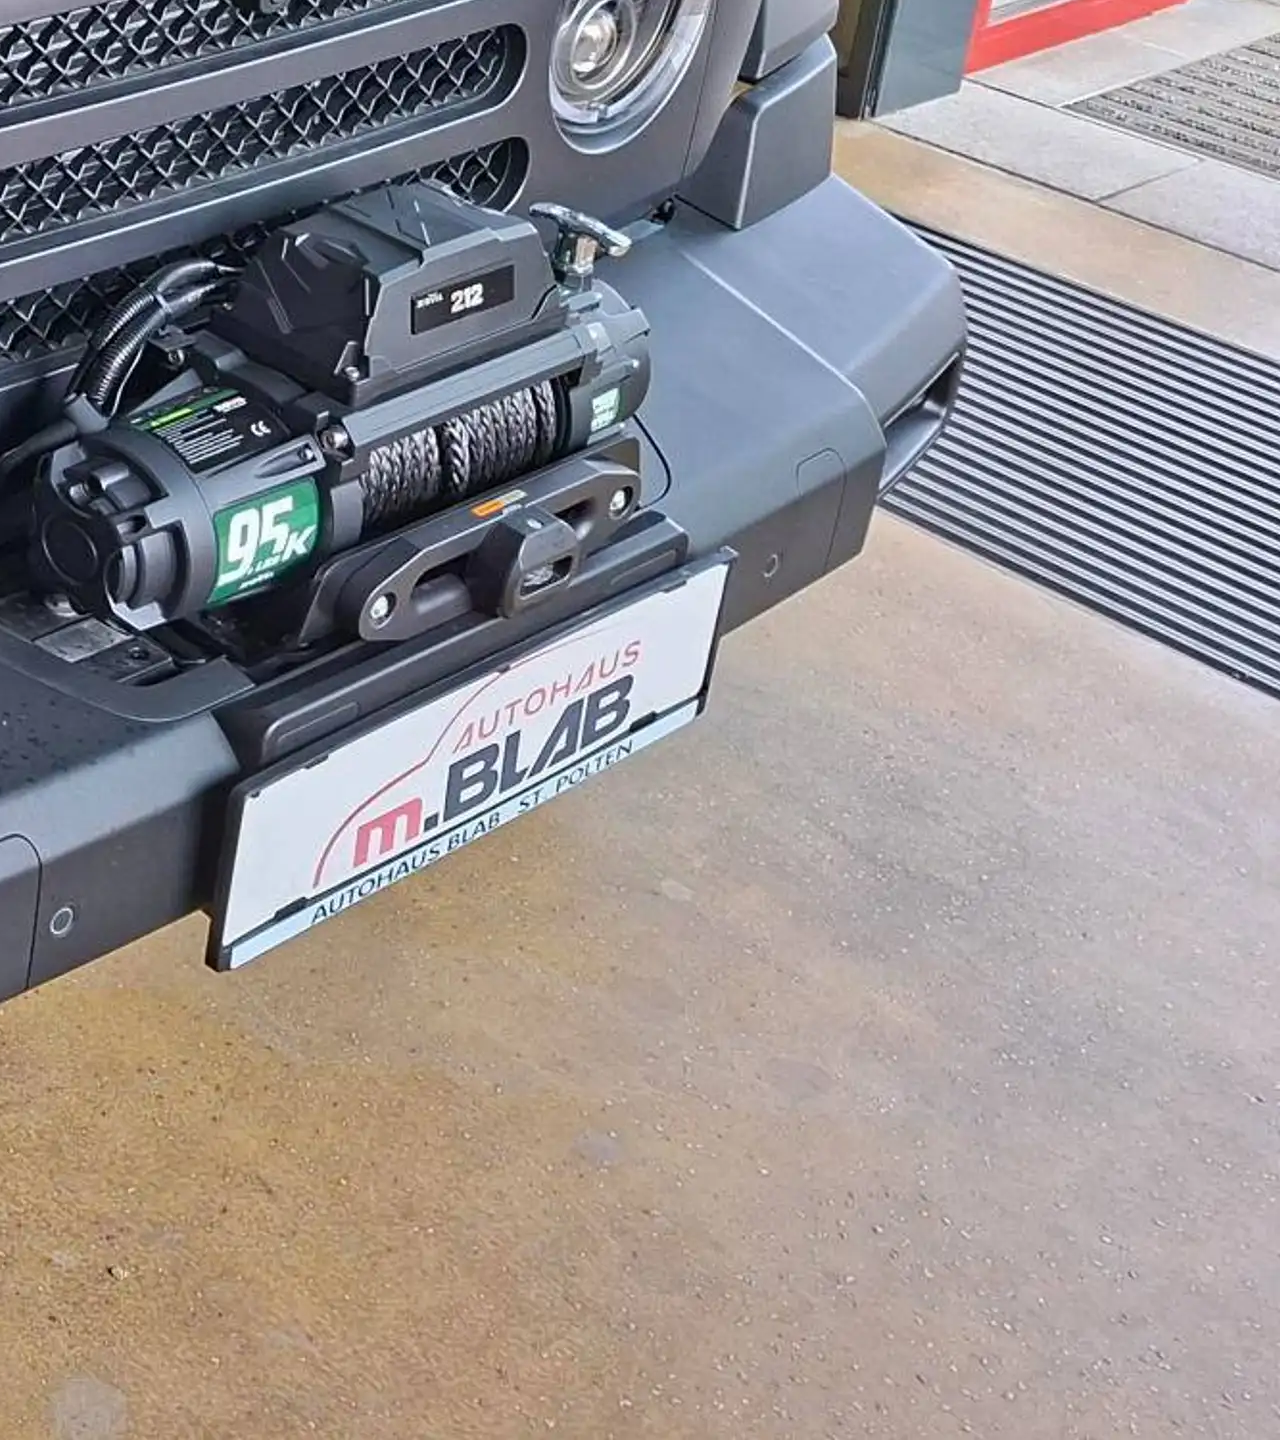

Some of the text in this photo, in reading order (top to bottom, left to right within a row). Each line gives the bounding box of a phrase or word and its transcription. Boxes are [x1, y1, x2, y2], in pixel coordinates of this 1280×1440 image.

[450, 282, 484, 314] 212
[452, 640, 642, 755] AUTOHAUS
[310, 843, 441, 924] AUTOHAUS
[447, 811, 501, 851] BLAB
